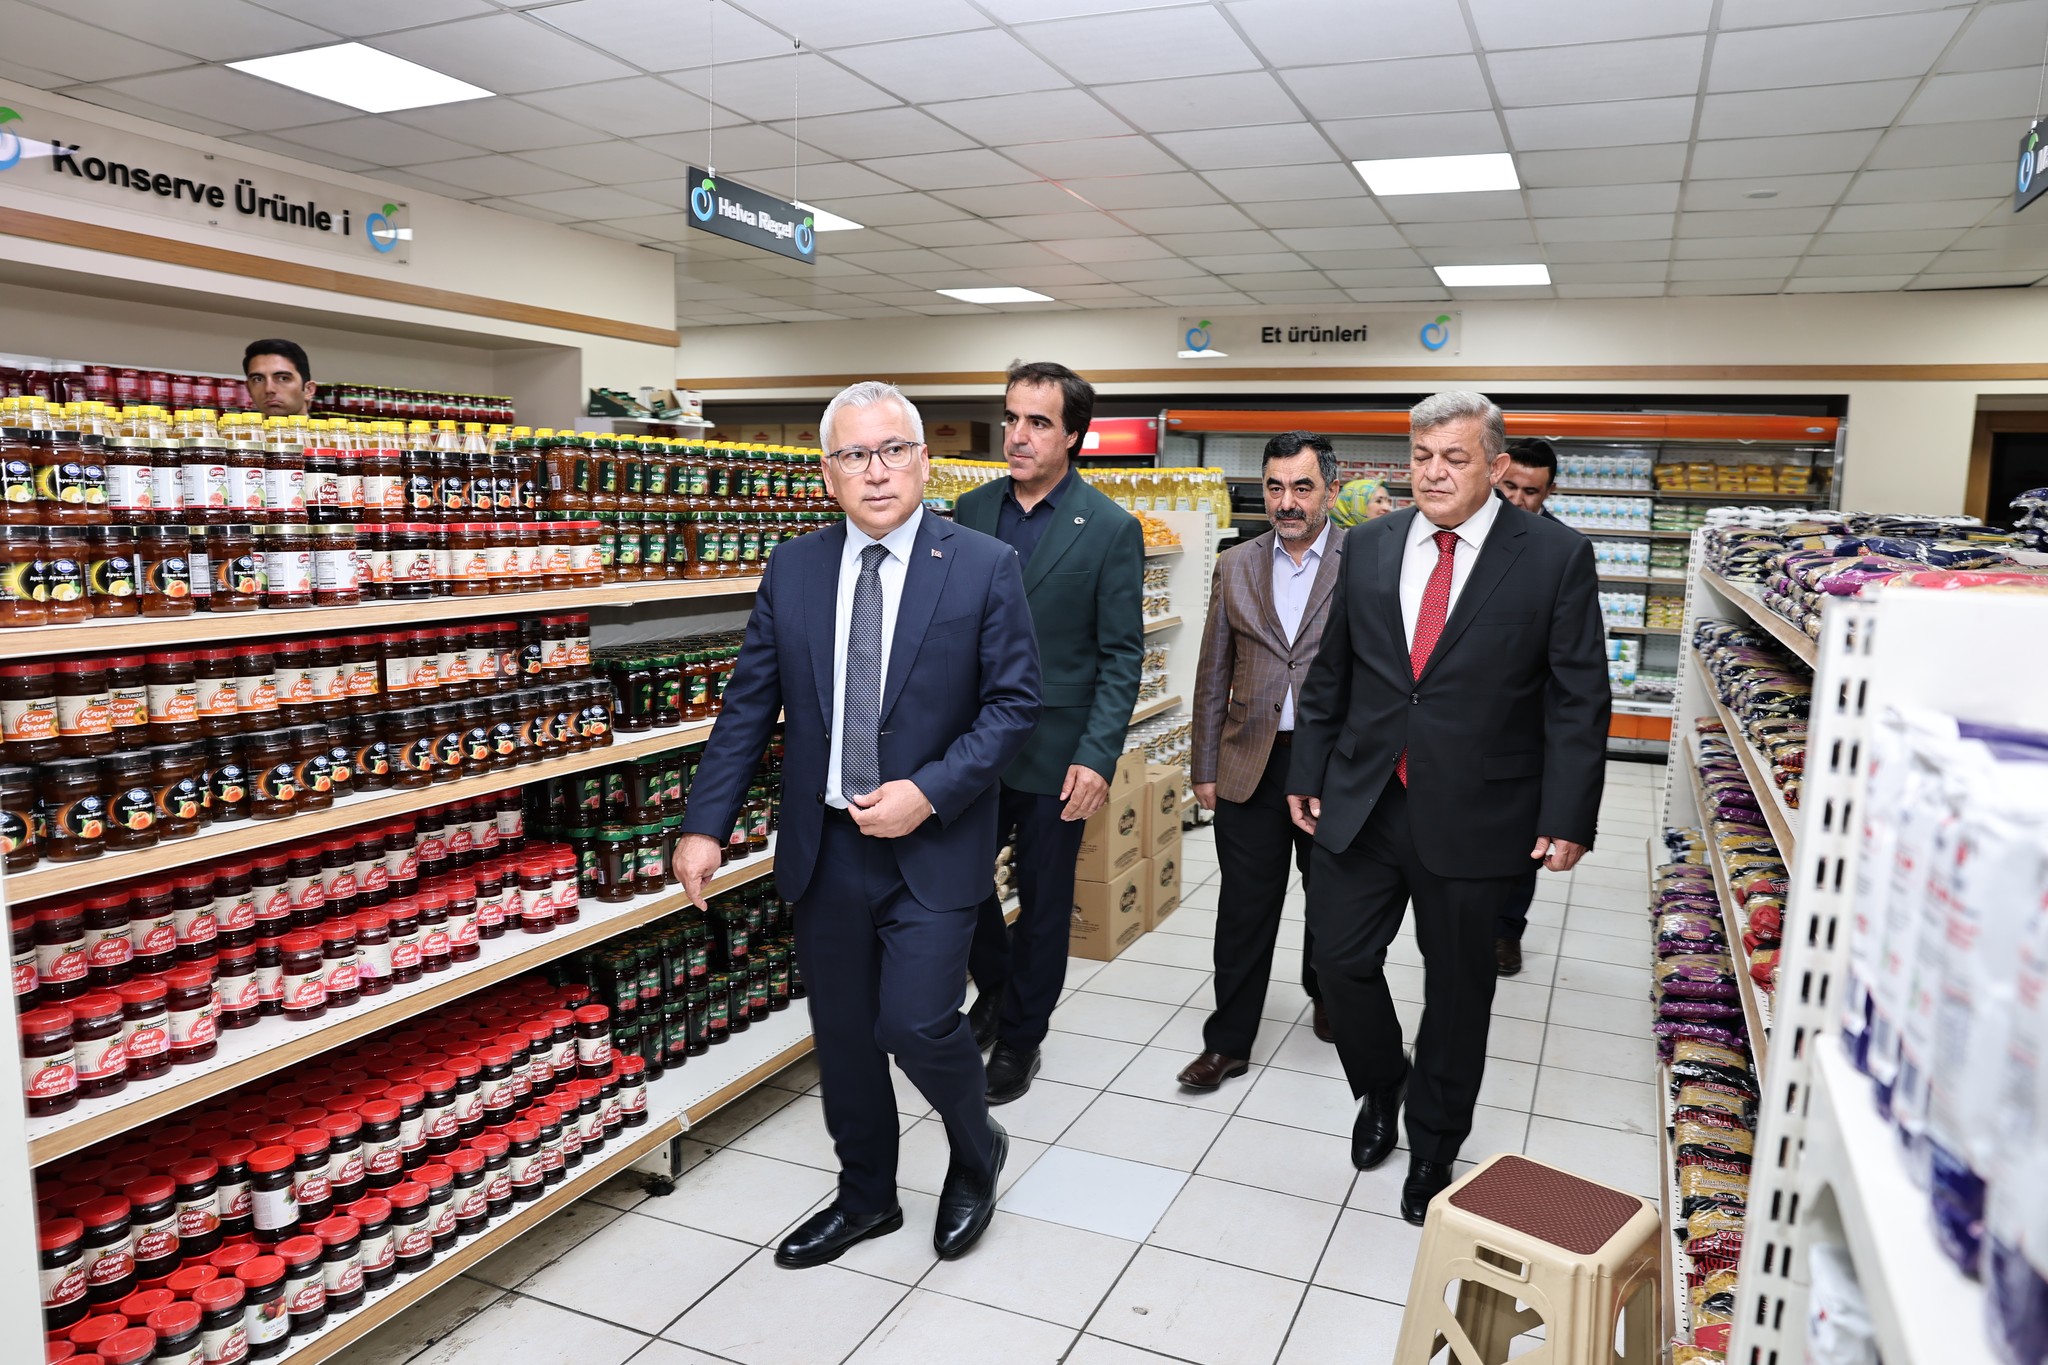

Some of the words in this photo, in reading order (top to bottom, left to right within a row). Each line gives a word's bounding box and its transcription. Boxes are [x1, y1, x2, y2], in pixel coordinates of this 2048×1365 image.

[51, 139, 225, 208] Konserve
[717, 196, 757, 227] Helva
[1261, 327, 1281, 343] Et
[1288, 325, 1367, 343] ürünleri
[169, 706, 194, 715] Reçeli
[20, 722, 50, 732] Reçeli
[80, 718, 107, 729] Reçeli
[455, 833, 468, 842] Gül
[424, 841, 438, 850] Gül
[371, 869, 385, 879] Gül
[337, 877, 351, 886] Gül
[308, 886, 321, 895] Gül
[274, 896, 288, 905] Gül
[537, 900, 551, 908] Gül
[236, 906, 251, 916] Gül
[482, 905, 497, 914] Gül
[195, 919, 212, 929] Gül
[232, 913, 253, 924] Reçeli
[191, 926, 214, 937] Reçeli
[465, 923, 478, 933] Gül
[152, 928, 169, 940] Gül
[100, 940, 121, 952] Gül
[147, 938, 173, 948] Reçeli
[427, 935, 443, 946] Gül
[94, 950, 122, 960] Reçeli
[397, 946, 413, 956] Gül
[60, 953, 81, 966] Gül
[55, 964, 83, 976] Reçeli
[335, 968, 351, 978] Gül
[301, 983, 318, 994] Gül
[298, 991, 320, 1002] Reçeli
[197, 1018, 212, 1029] Gül
[135, 1030, 155, 1042] Gül
[130, 1038, 158, 1051] Reçeli
[107, 1047, 123, 1060] Gül
[41, 1067, 63, 1081] Gül
[36, 1078, 66, 1090] Reçeli
[300, 1187, 325, 1198] Reçeli
[137, 1242, 164, 1253] Reçeli
[92, 1263, 123, 1278] Reçeli
[62, 1271, 85, 1288] Çile
[227, 1330, 247, 1347] Çile
